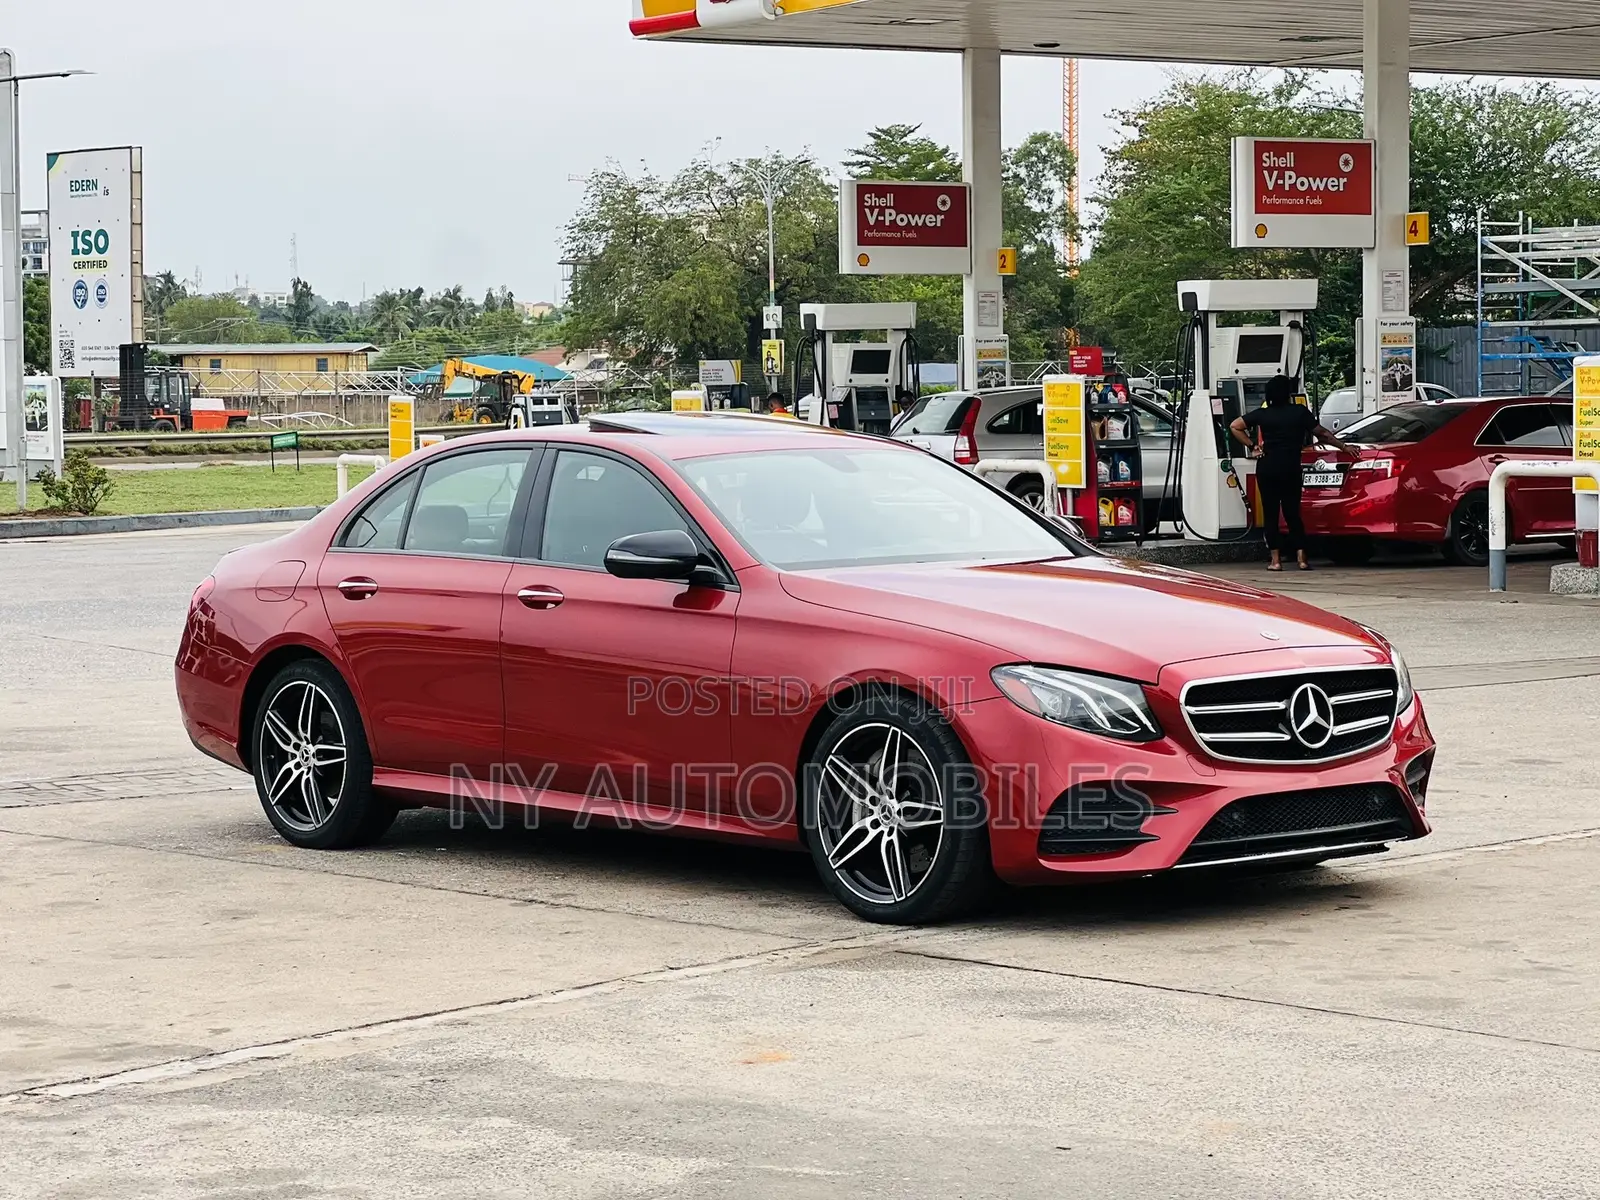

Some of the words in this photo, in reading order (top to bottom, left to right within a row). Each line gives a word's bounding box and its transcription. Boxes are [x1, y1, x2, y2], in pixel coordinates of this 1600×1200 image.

[1262, 151, 1294, 167] Shell
[70, 179, 98, 192] EDERN
[103, 186, 110, 196] is
[1263, 170, 1347, 191] V-Power
[864, 193, 894, 206] Shell
[1262, 194, 1304, 205] Performance
[1305, 195, 1322, 205] Fuels
[864, 208, 945, 227] V-Power
[864, 229, 901, 238] Performance
[902, 230, 917, 238] Fuels
[1409, 220, 1418, 237] 4
[71, 229, 109, 255] ISO
[73, 260, 108, 270] CERTIFIED
[1000, 254, 1006, 268] 2
